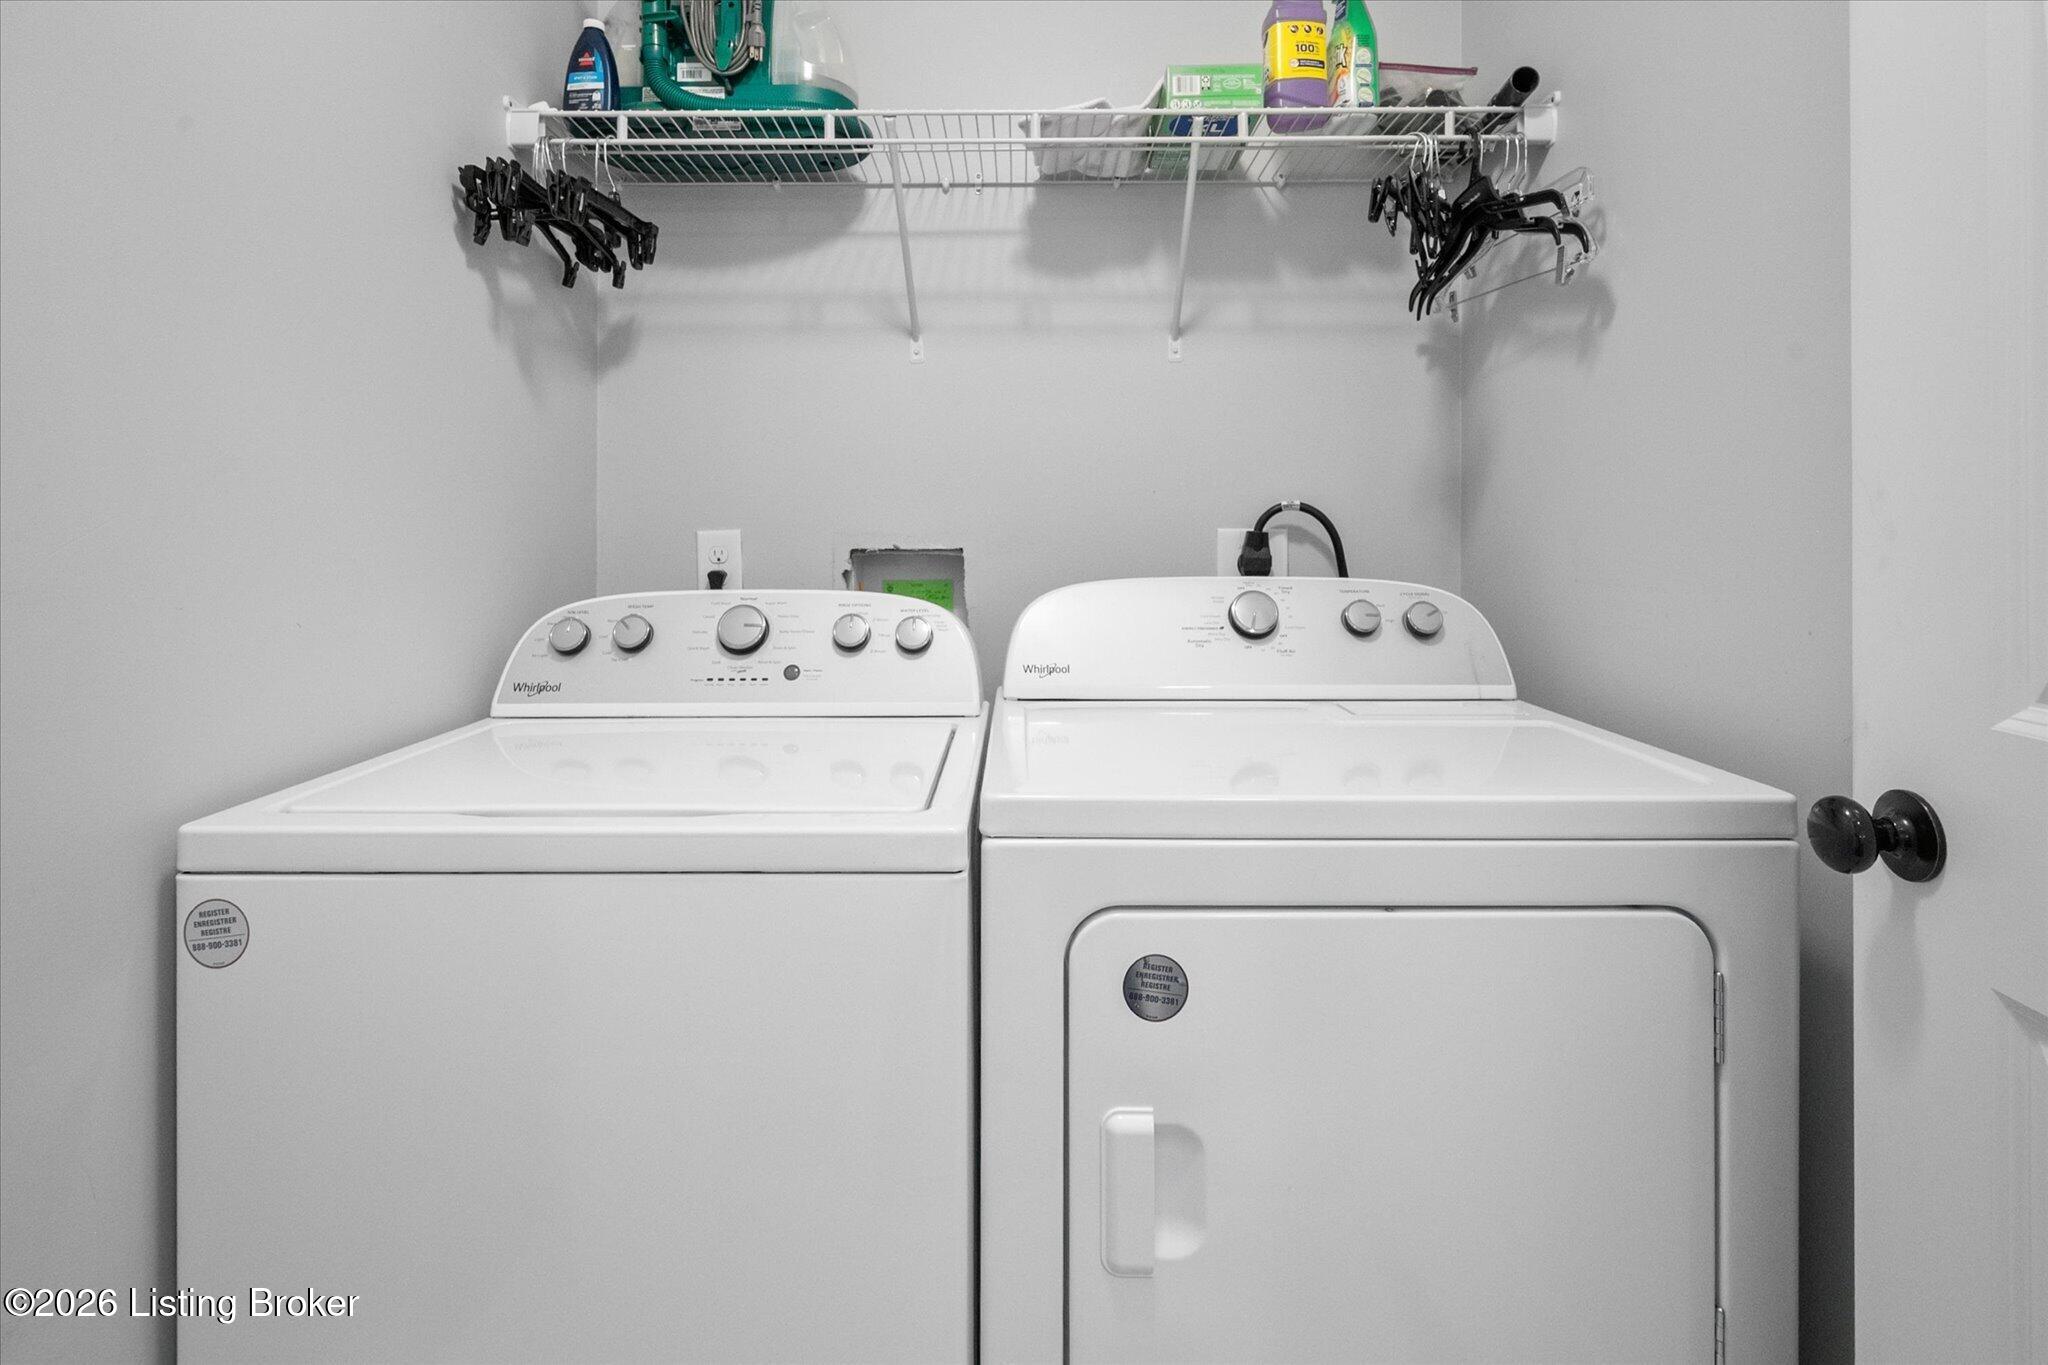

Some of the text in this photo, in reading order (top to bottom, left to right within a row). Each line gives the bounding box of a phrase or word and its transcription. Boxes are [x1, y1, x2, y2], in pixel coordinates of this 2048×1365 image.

[1295, 44, 1315, 52] 100
[1022, 662, 1071, 679] Whirlpool
[513, 681, 562, 698] Whirlpool
